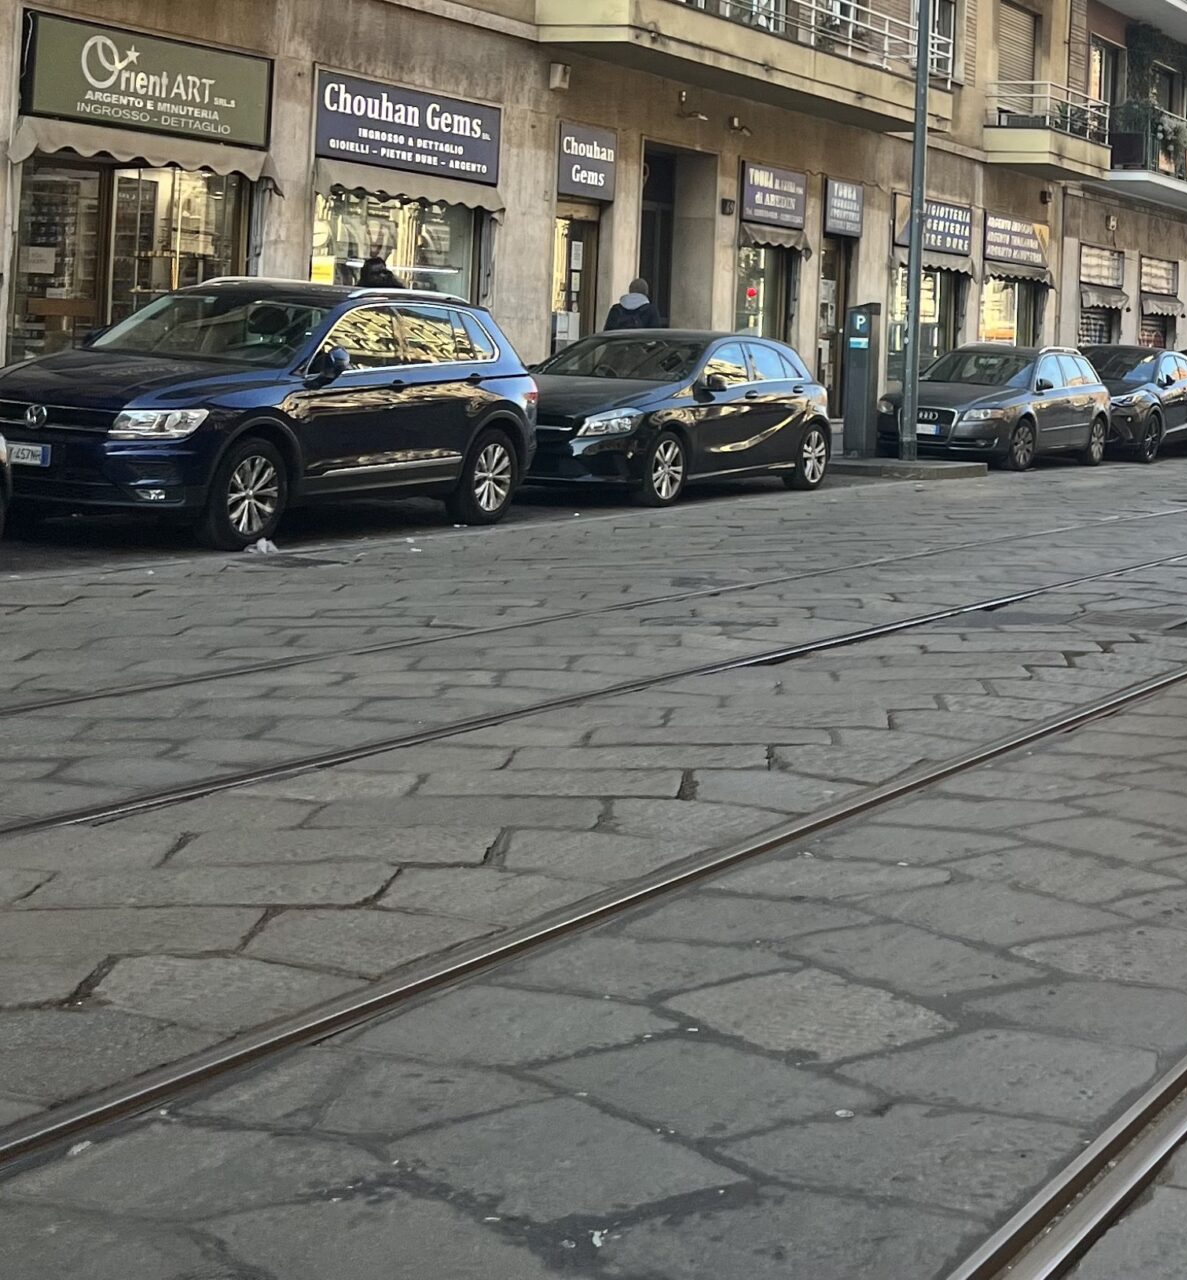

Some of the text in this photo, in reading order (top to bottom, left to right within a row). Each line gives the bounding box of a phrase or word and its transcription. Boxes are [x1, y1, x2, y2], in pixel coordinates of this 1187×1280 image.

[76, 101, 151, 122] INGROSSO
[161, 115, 231, 135] DETTAGLIO
[84, 89, 220, 121] ARGENTO E MINUTERIA
[324, 83, 420, 128] Chouhan
[426, 103, 482, 139] Gems
[358, 127, 405, 145] INGROSSO
[416, 139, 464, 157] DETTAGLIO
[563, 136, 615, 163] Chouhan
[329, 138, 370, 155] GIOIELLI
[380, 146, 414, 163] PIETRE
[415, 153, 438, 167] DURE
[448, 158, 488, 175] ARGENTO
[571, 164, 606, 188] Gems
[926, 218, 970, 237] GENTERIA
[925, 233, 970, 252] TRE DURE
[856, 314, 867, 330] P
